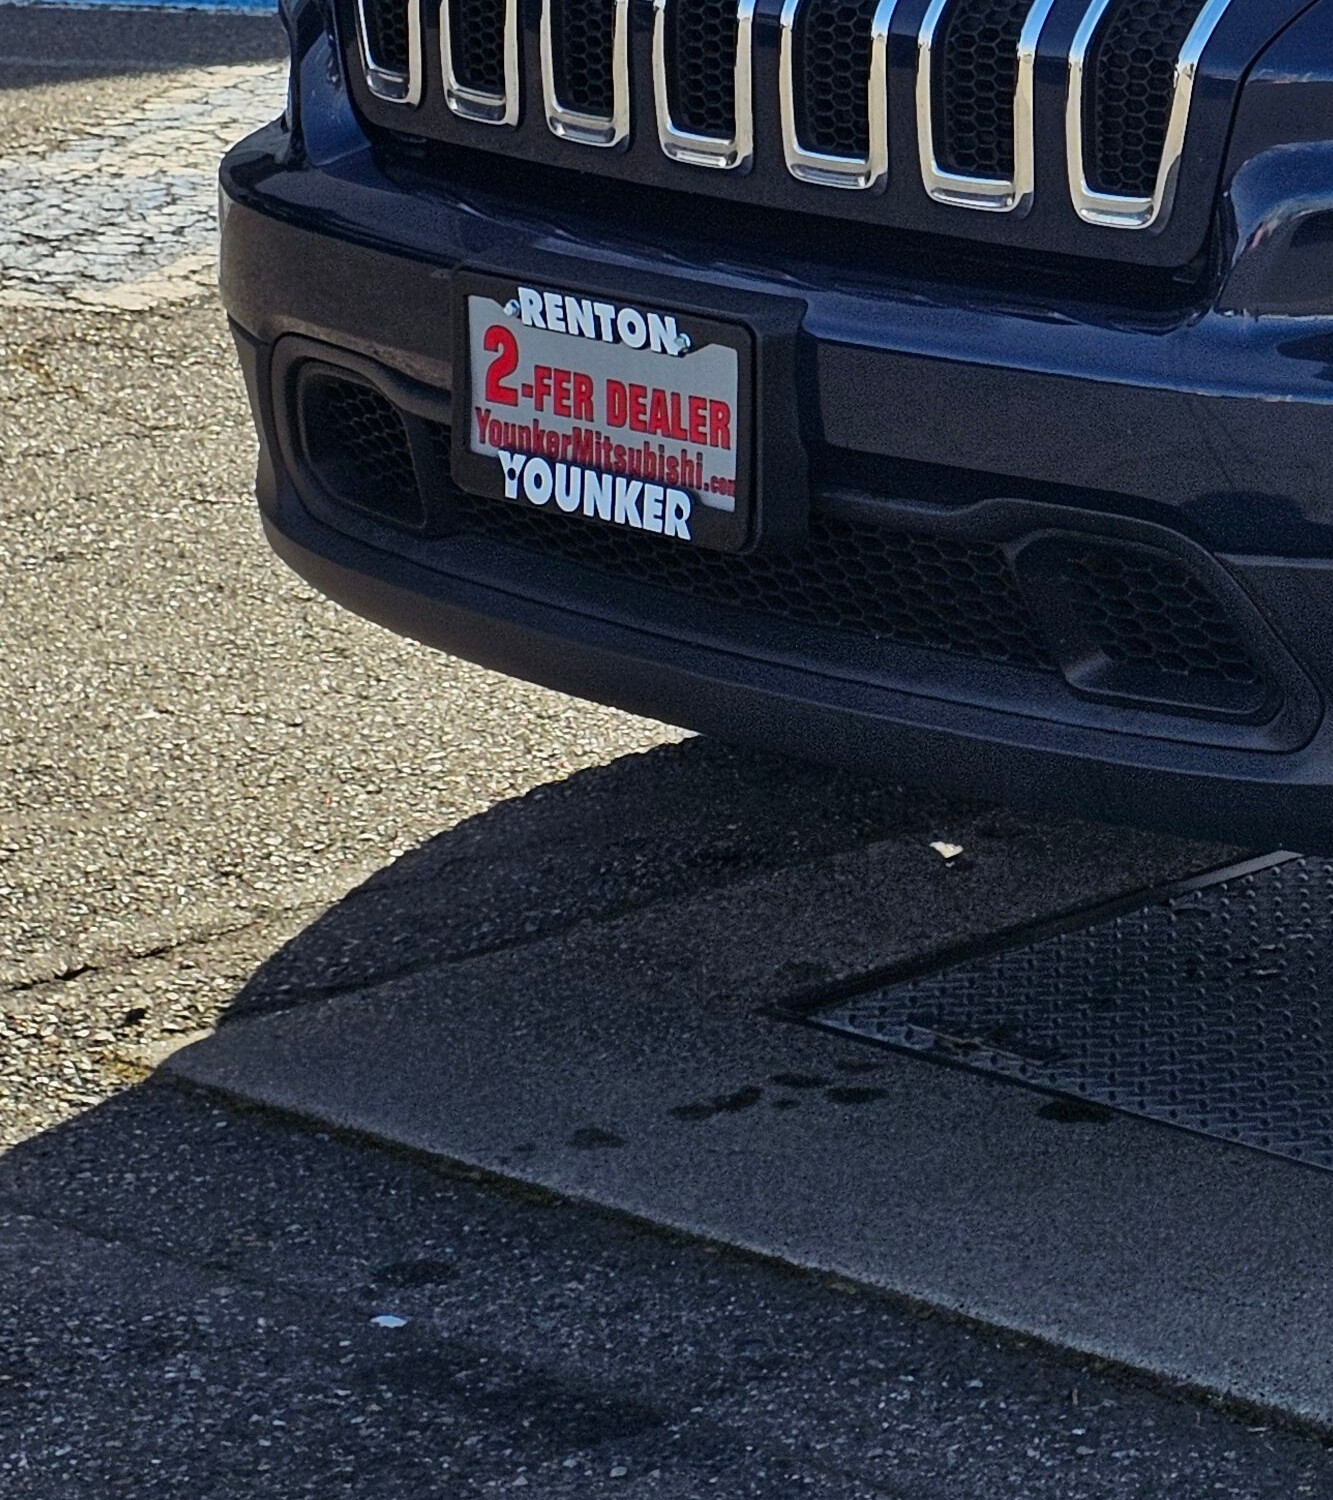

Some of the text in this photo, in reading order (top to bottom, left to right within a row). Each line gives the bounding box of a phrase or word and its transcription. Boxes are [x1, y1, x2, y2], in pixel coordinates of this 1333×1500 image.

[517, 286, 681, 357] RENTON
[483, 324, 732, 450] 2-FER DEALER
[498, 450, 692, 541] YOUNKER
